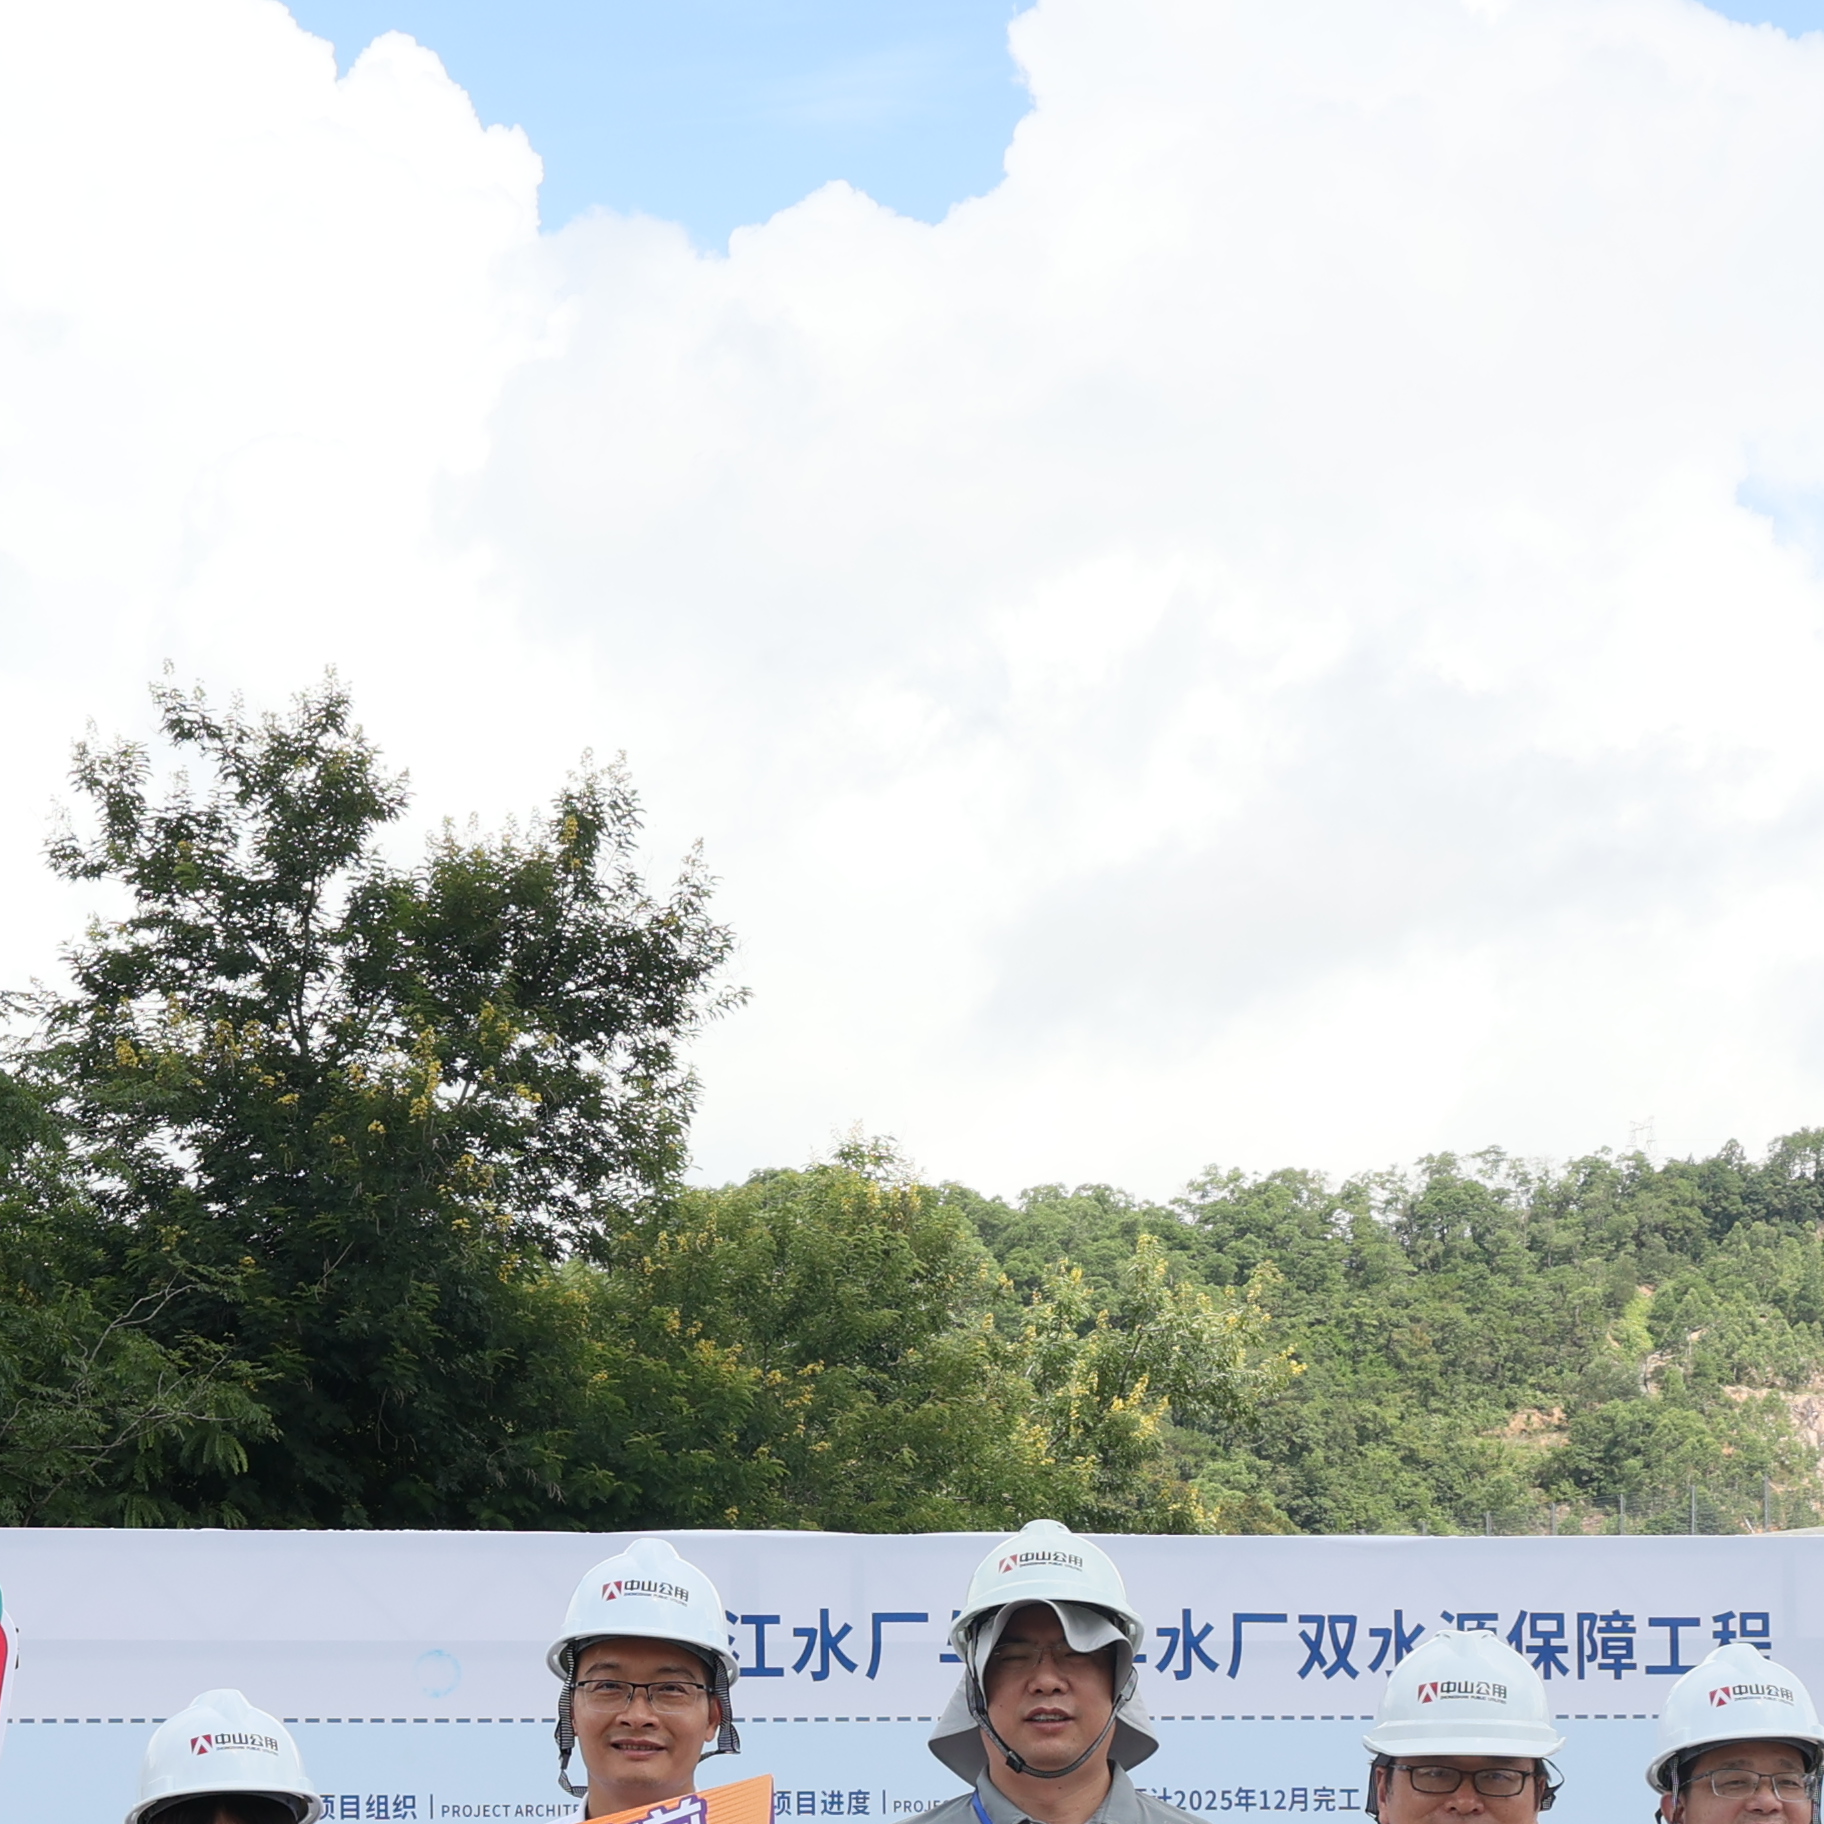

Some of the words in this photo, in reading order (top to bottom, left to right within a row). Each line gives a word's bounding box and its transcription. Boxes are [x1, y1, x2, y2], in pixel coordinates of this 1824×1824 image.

[1019, 1551, 1083, 1568] 中山公用
[624, 1580, 689, 1602] 中山公用
[1440, 1681, 1507, 1699] 中山公用
[1732, 1683, 1794, 1702] 中山公用
[214, 1733, 279, 1752] 中山公用
[319, 1793, 417, 1821] 项目组织
[441, 1804, 511, 1818] PROJECT
[773, 1790, 871, 1816] 项目进度
[1134, 1787, 1361, 1813] 计2025年12月完工
